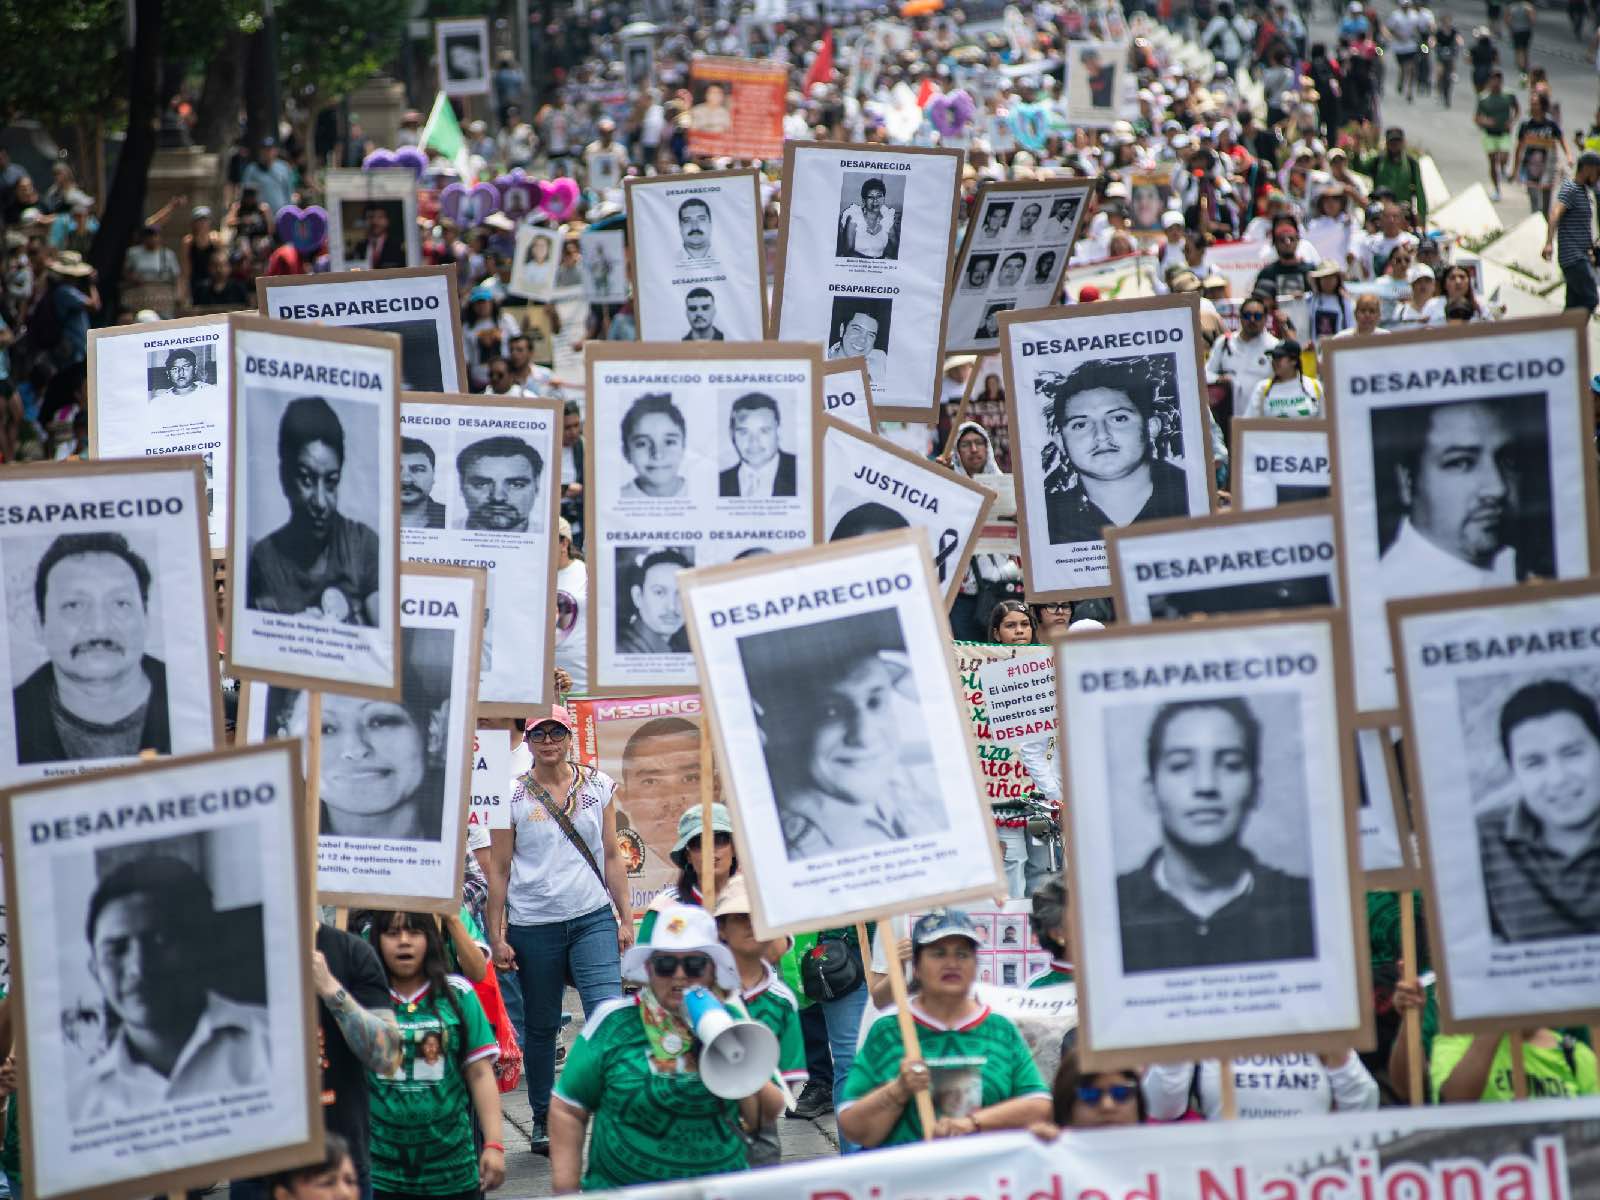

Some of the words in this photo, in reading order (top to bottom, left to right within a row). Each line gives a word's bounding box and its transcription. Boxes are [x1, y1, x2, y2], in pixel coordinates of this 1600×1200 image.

[839, 159, 912, 171] DESAPARECIDA
[828, 284, 901, 295] DESAPARECIDO
[279, 295, 440, 320] DESAPARECIDO
[144, 333, 220, 348] DESAPARECIDO
[1021, 327, 1184, 357] DESAPARECIDO
[245, 355, 383, 391] DESAPARECIDA
[604, 374, 702, 384] DESAPARECIDO
[708, 373, 806, 384] DESAPARECIDO
[1350, 357, 1566, 395] DESAPARECIDO
[458, 418, 547, 430] DESAPARECIDO
[145, 441, 221, 456] DESAPARECIDO
[854, 465, 939, 514] JUSTICIA
[606, 531, 703, 541] DESAPARECIDO
[709, 529, 807, 540] DESAPARECIDO
[1135, 542, 1335, 582] DESAPARECIDO
[710, 573, 912, 628] DESAPARECIDO
[1080, 653, 1319, 694] DESAPARECIDO
[989, 686, 999, 696] El
[1001, 681, 1030, 694] único
[991, 694, 1033, 710] importa
[1035, 691, 1047, 700] es
[992, 708, 1037, 724] nuestros
[30, 781, 276, 843] DESAPARECIDO
[1234, 1069, 1321, 1089] ESTÁN?
